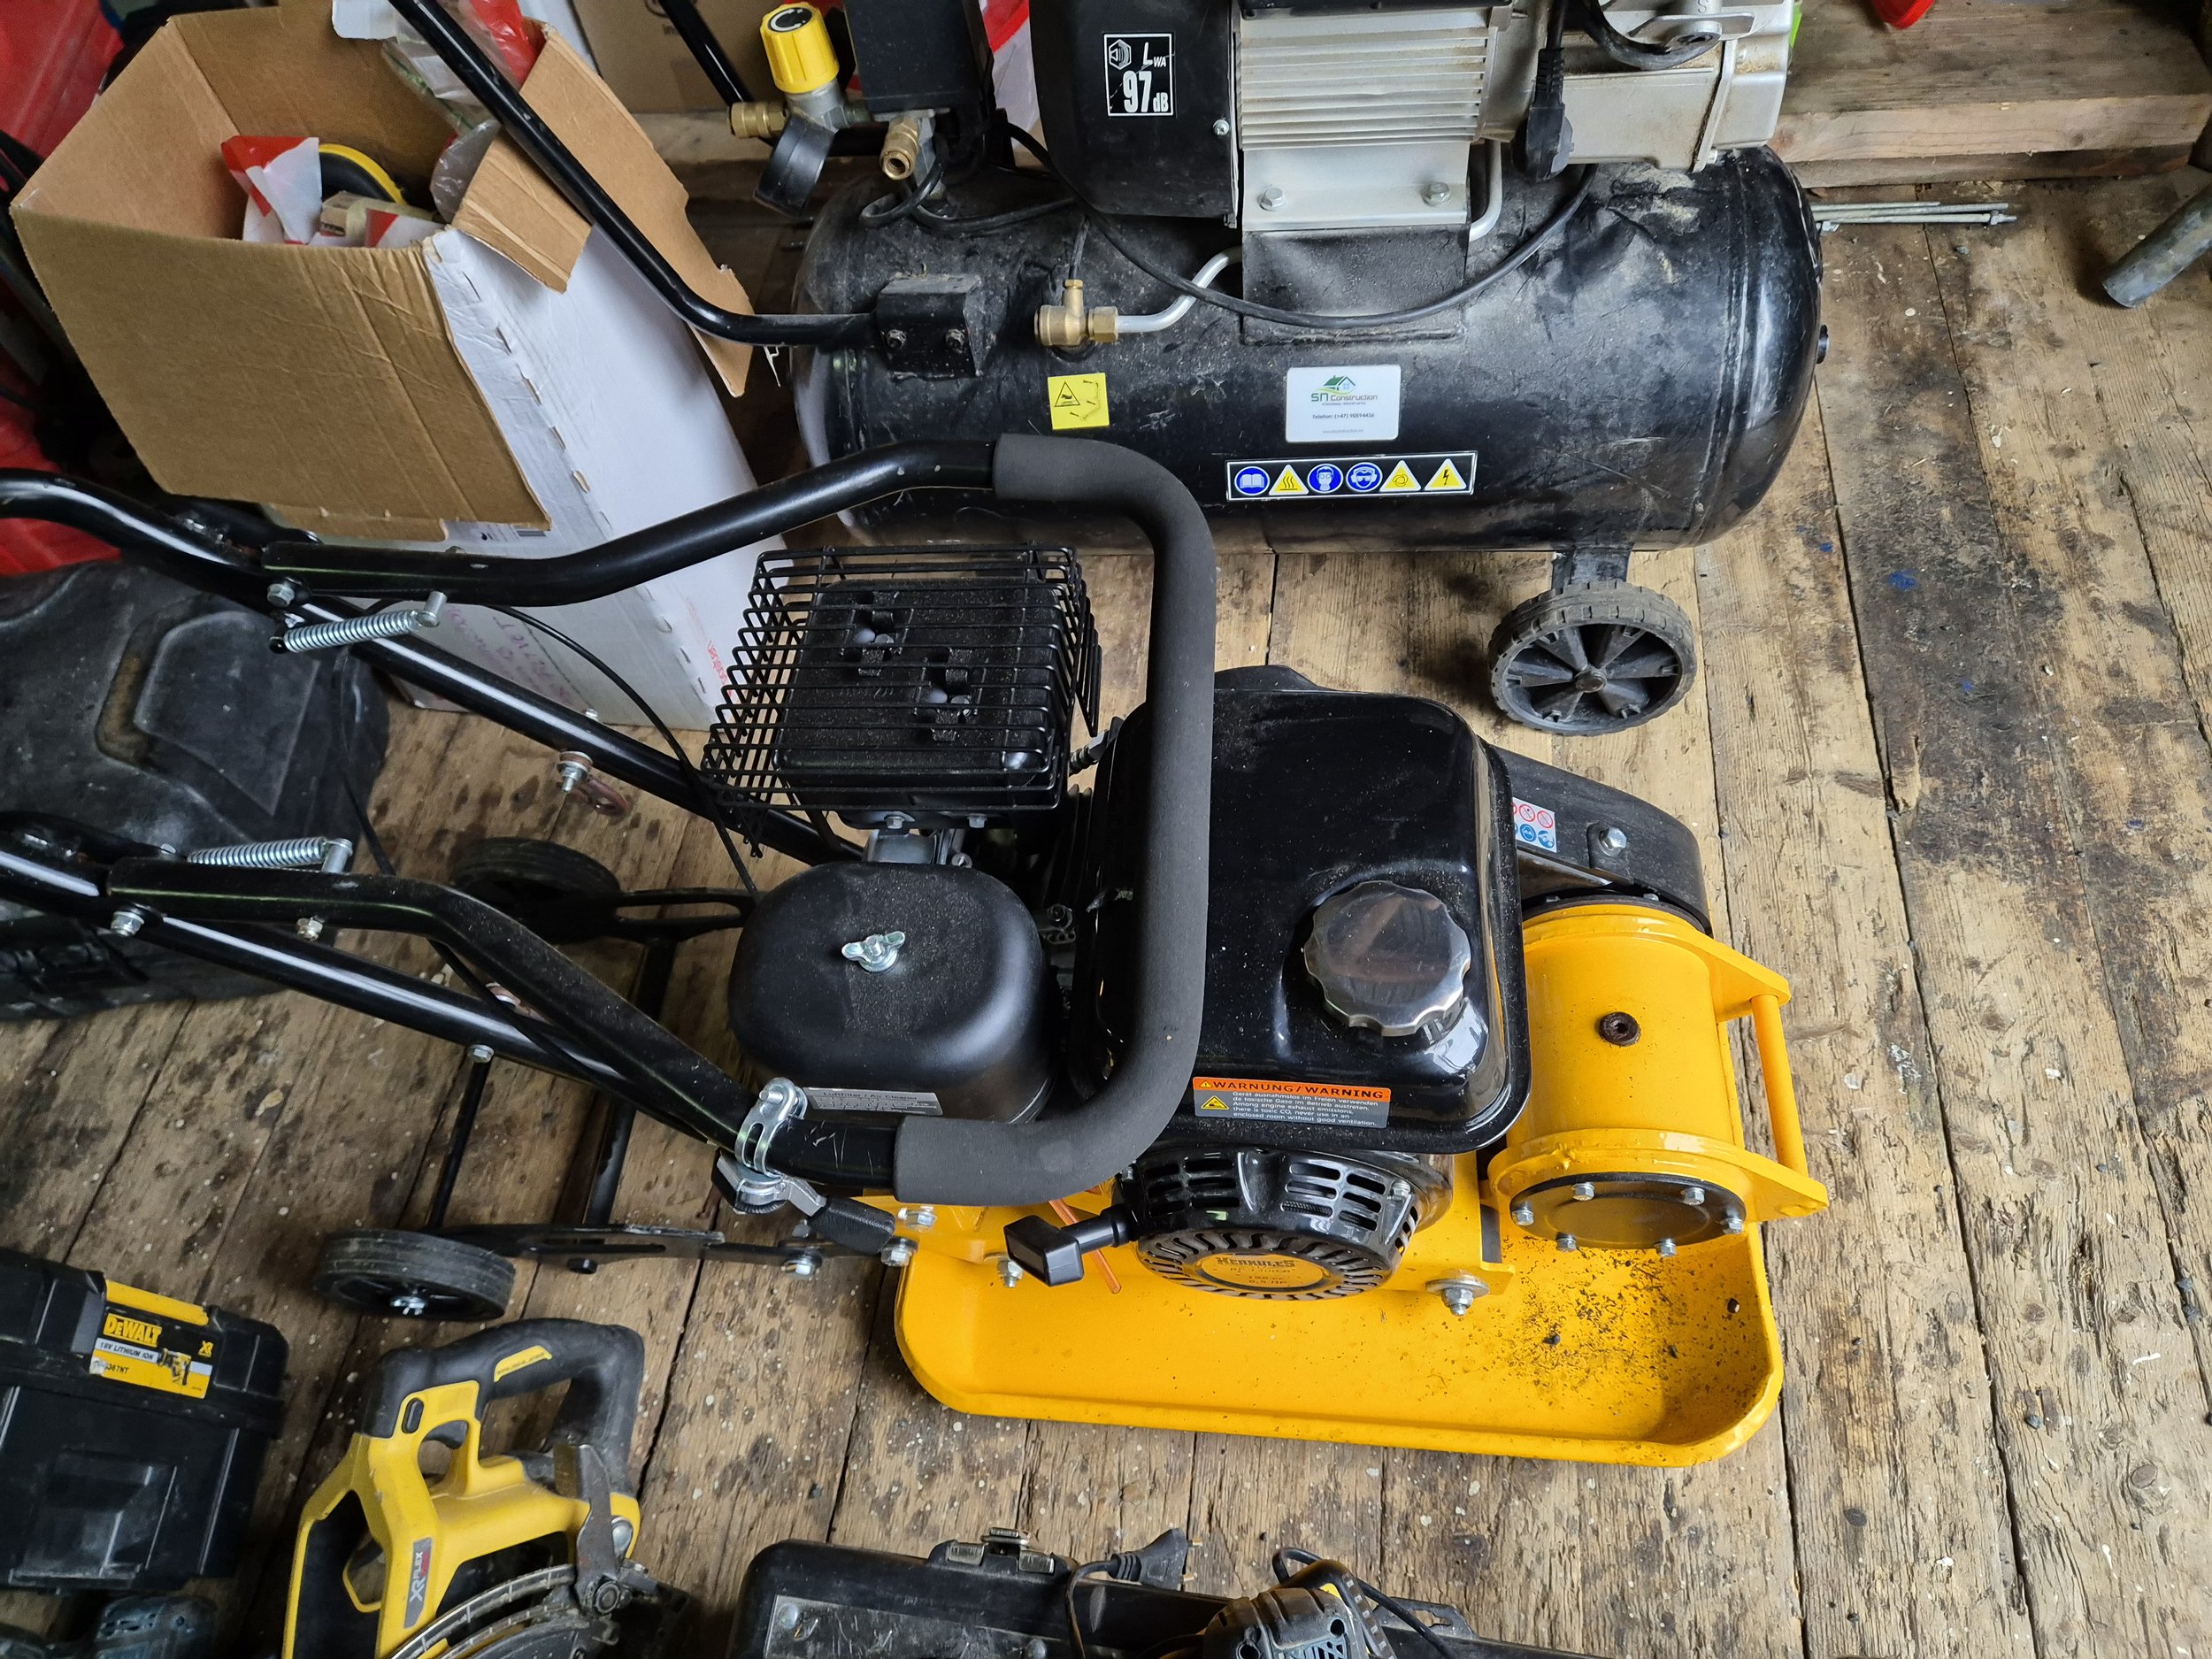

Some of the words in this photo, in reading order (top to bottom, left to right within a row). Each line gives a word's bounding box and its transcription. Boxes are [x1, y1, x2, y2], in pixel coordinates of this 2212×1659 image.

[1123, 70, 1152, 113] 97
[1152, 92, 1169, 112] dB
[113, 1344, 141, 1356] LITHIUM
[413, 1551, 424, 1579] FLEX
